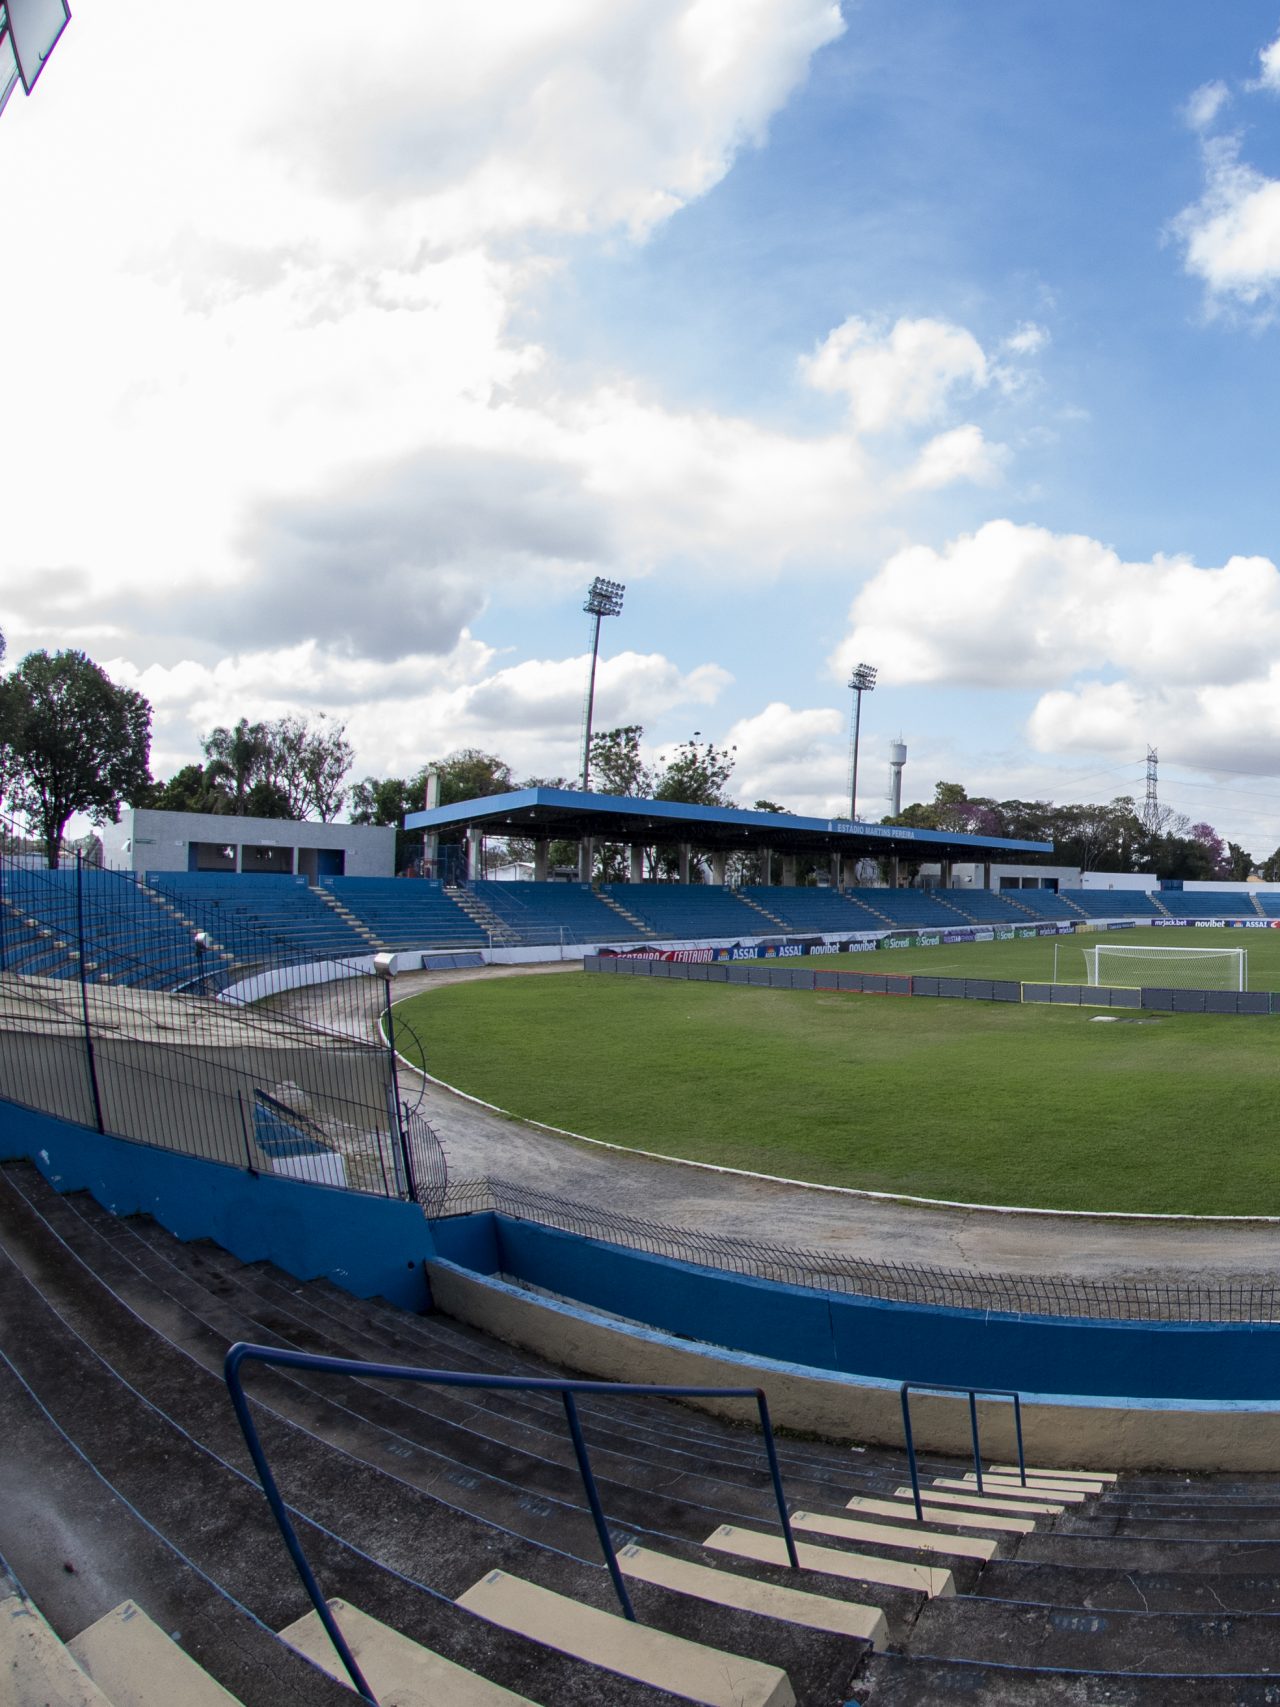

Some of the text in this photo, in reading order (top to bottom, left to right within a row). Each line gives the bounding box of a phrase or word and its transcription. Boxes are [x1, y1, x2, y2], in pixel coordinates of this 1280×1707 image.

[865, 826, 890, 836] MARTINS
[891, 829, 915, 839] PEREIRA
[1195, 920, 1225, 928] novibet
[849, 940, 876, 953] novibet
[889, 938, 910, 949] Sicredi
[921, 935, 939, 946] Sicredi
[810, 941, 840, 955] novibet
[673, 949, 714, 963] CENTAURO
